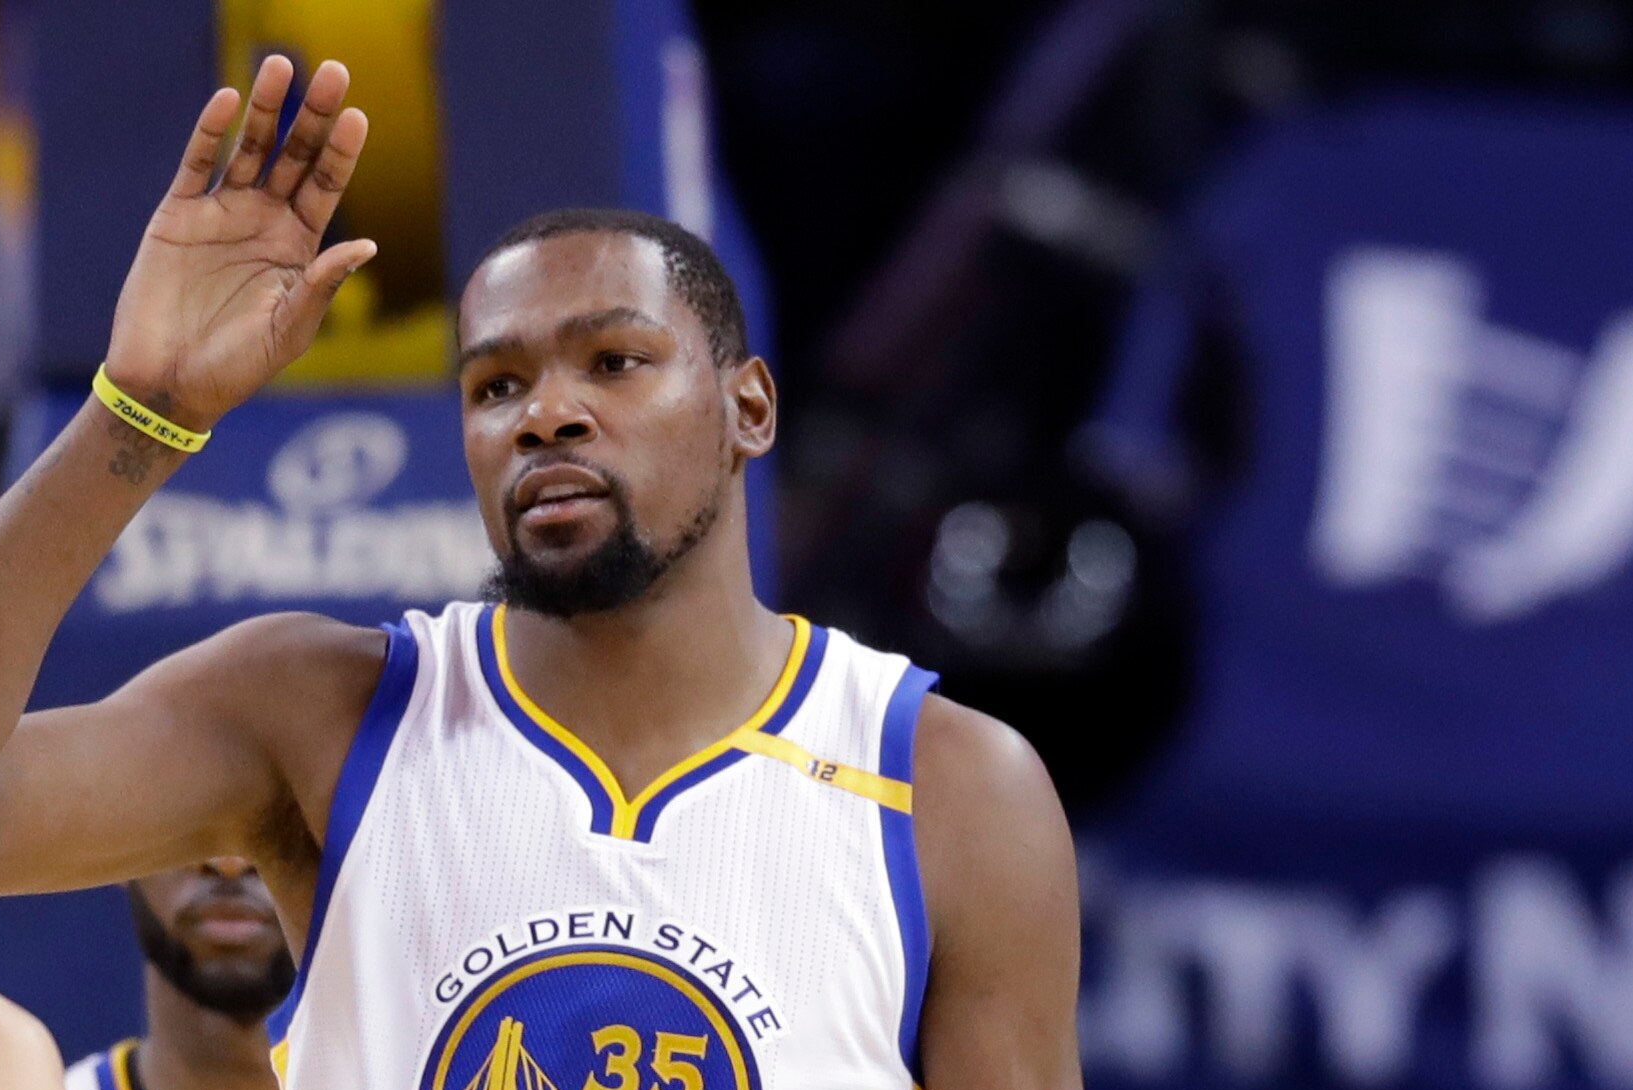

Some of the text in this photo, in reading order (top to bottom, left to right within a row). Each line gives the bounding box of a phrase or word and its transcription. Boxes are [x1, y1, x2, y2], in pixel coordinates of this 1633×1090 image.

[113, 398, 152, 426] JOHN
[435, 911, 782, 1039] GOLDEN STATE
